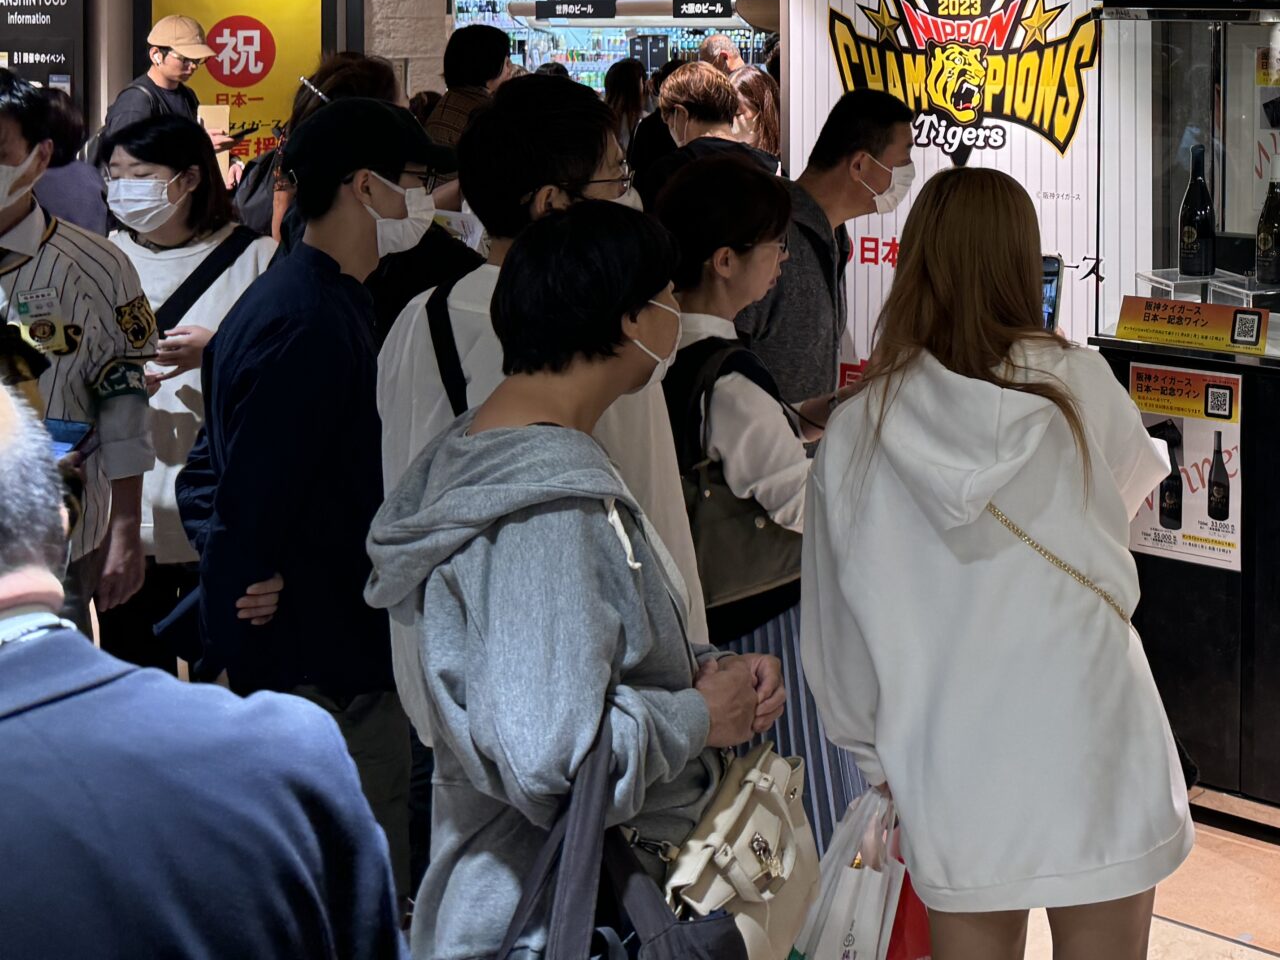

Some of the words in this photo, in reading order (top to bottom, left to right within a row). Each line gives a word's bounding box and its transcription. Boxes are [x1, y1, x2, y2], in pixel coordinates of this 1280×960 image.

[555, 4, 594, 15] 世界のビール
[680, 3, 724, 15] 大阪のビール
[8, 12, 50, 25] information
[215, 28, 264, 76] 祝
[833, 12, 1099, 144] CHAMPIONS
[215, 92, 264, 108] 日本一
[914, 112, 1005, 153] Tigers
[1144, 300, 1201, 315] 阪神タイガース
[1143, 313, 1208, 327] 日本一記念ワイン
[1136, 372, 1192, 386] 阪神タイガース
[1136, 383, 1200, 399] 日本一記念ワイン
